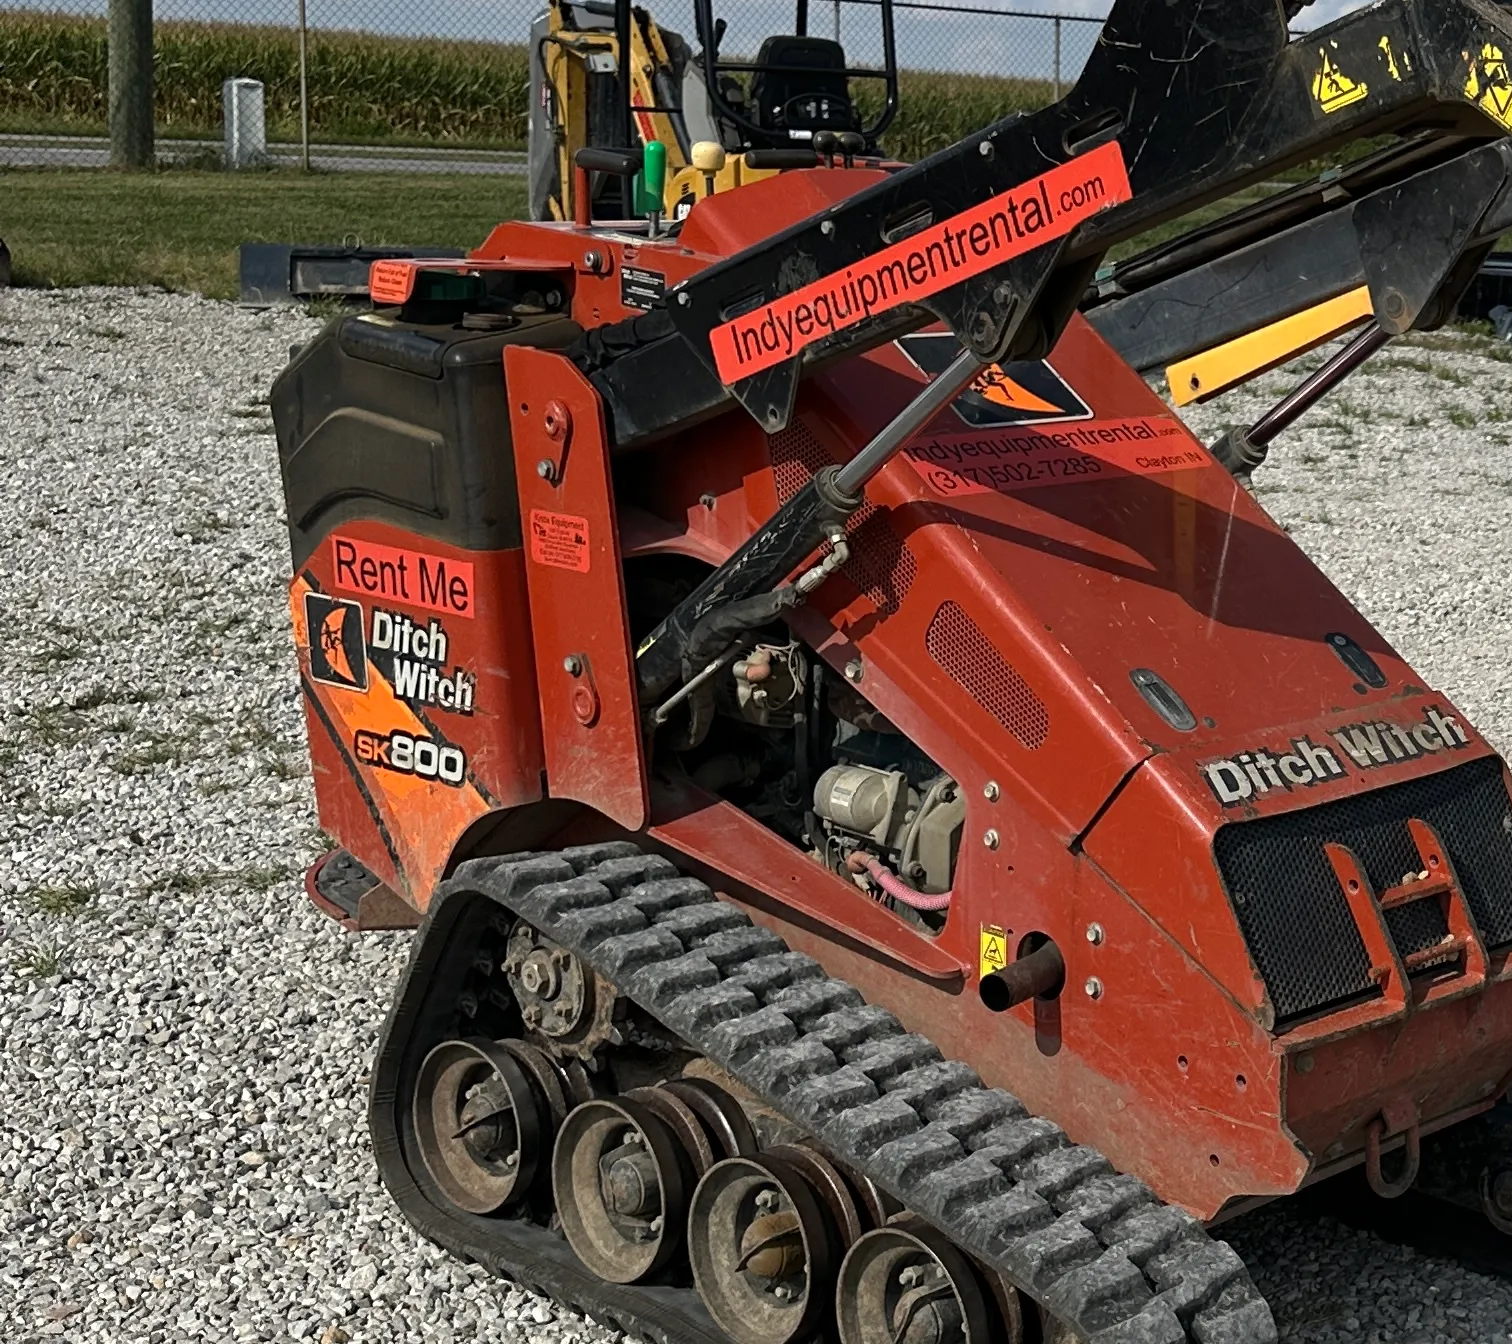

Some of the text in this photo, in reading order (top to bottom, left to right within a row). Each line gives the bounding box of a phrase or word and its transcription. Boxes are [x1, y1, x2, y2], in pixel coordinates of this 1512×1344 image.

[730, 174, 1106, 364] Indyequipmentrental.com
[927, 455, 1103, 495] (317)502-7285
[1135, 454, 1186, 470] Clayton
[336, 539, 469, 612] Rent Me
[372, 610, 448, 662] Ditch
[393, 656, 473, 711] Witch
[356, 734, 465, 783] SK800
[1204, 709, 1470, 804] Ditch Witch
